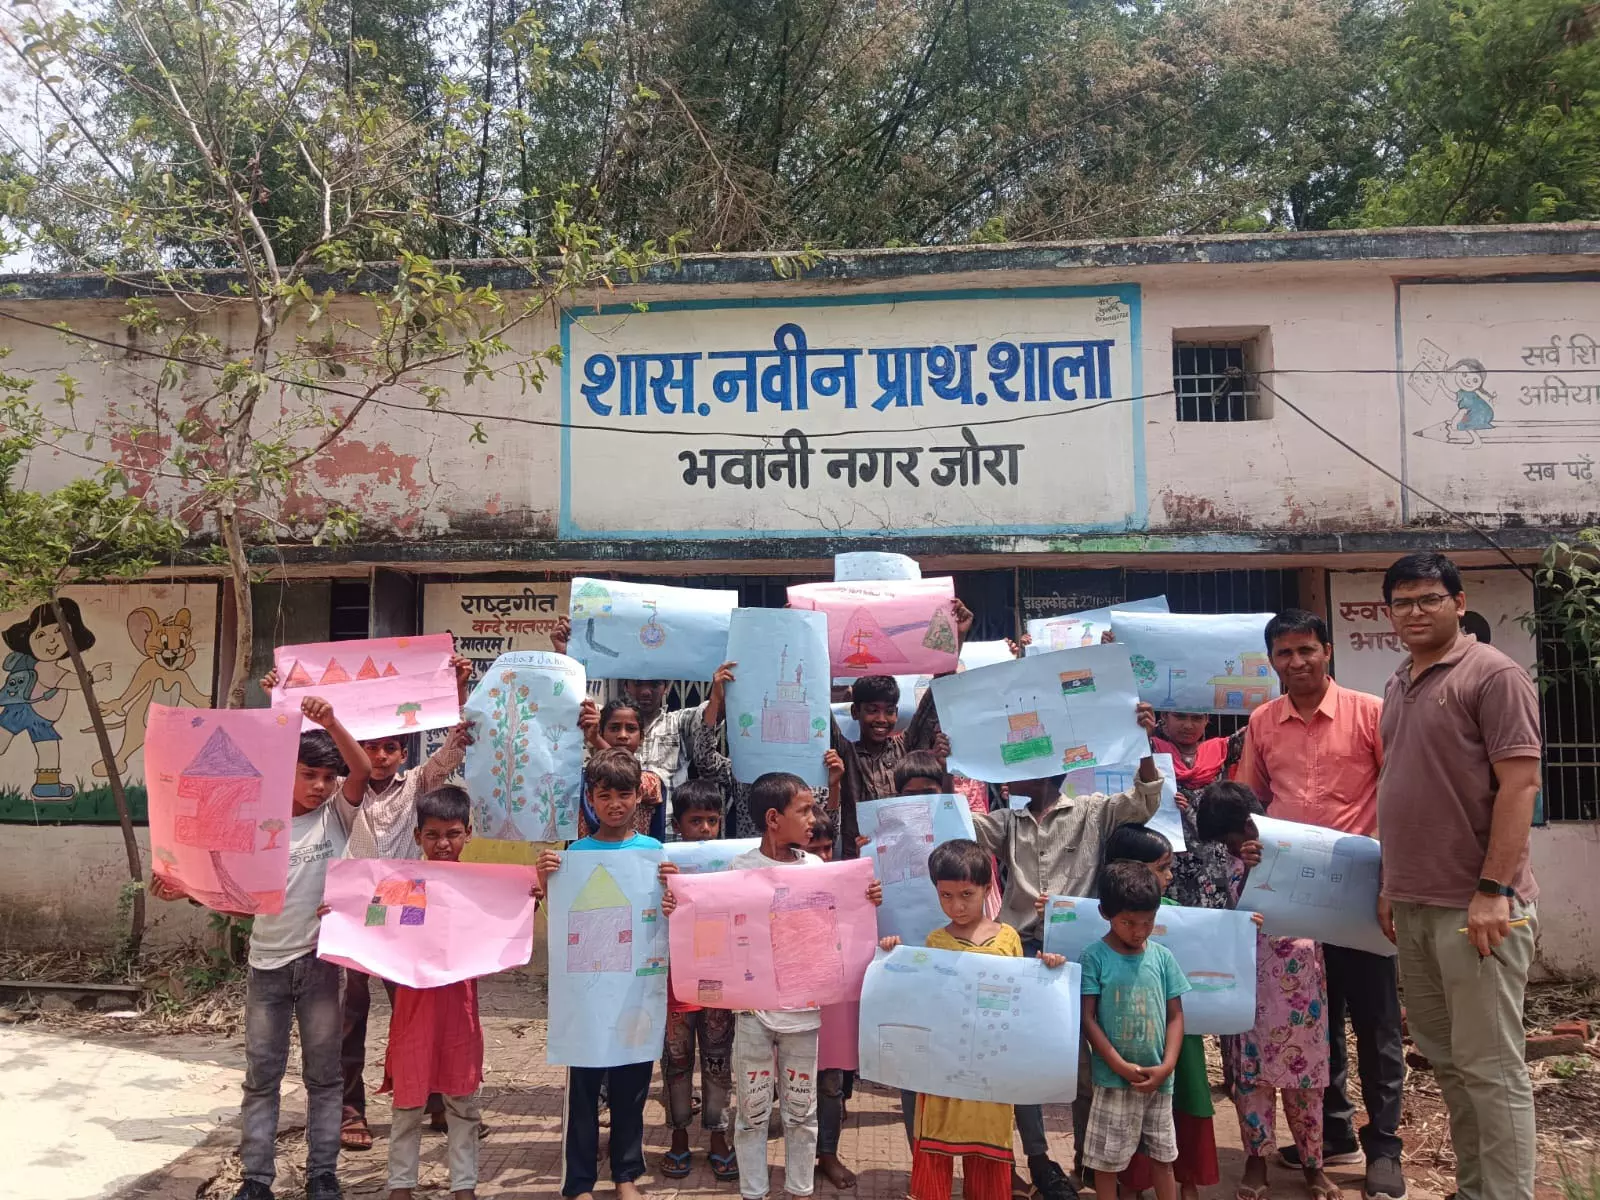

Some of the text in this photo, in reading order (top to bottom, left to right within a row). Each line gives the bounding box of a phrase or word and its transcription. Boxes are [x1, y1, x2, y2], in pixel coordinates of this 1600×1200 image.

[678, 426, 1025, 489] भवानी नगर जोरा
[1522, 462, 1559, 482] सब
[461, 587, 558, 616] राष्ट्रगीत
[1350, 632, 1409, 653] भार
